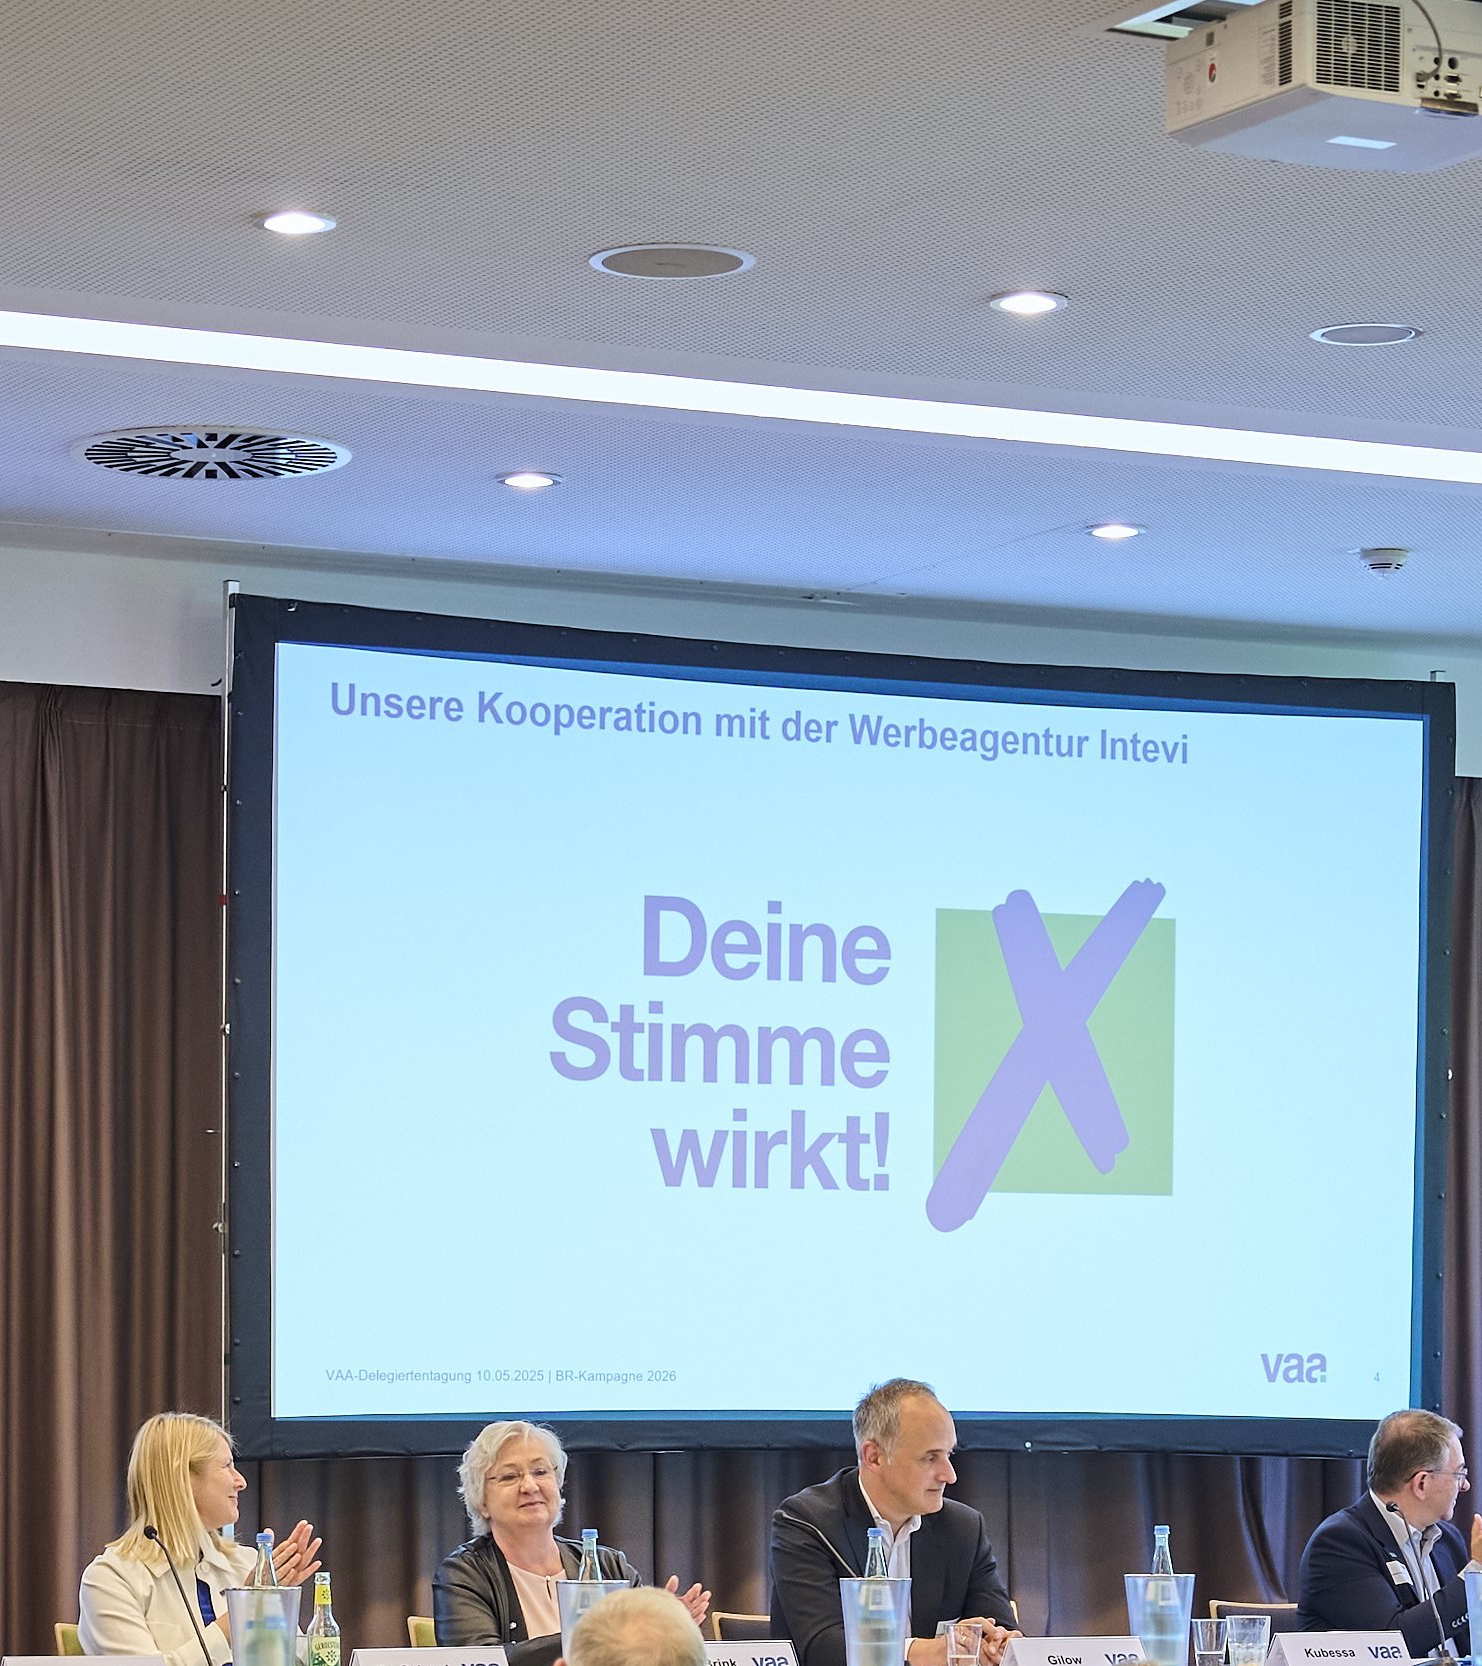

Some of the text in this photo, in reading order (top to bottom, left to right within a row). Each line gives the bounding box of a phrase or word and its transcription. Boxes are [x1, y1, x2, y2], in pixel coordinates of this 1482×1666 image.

[331, 682, 1188, 765] Unsere Kooperation mit der Werbeagentur Intevi
[643, 895, 891, 986] Deine
[550, 996, 891, 1089] Stimme
[650, 1108, 890, 1192] wirkt!
[326, 1369, 472, 1383] VAA-Delegiertentagung
[476, 1369, 545, 1382] 10.05.2025
[555, 1370, 644, 1384] BR-Kampagne
[647, 1370, 677, 1382] 2026
[1261, 1353, 1327, 1383] vaa
[1047, 1655, 1082, 1665] Gilow
[1304, 1648, 1356, 1658] Kubessa
[1368, 1646, 1402, 1658] vaa
